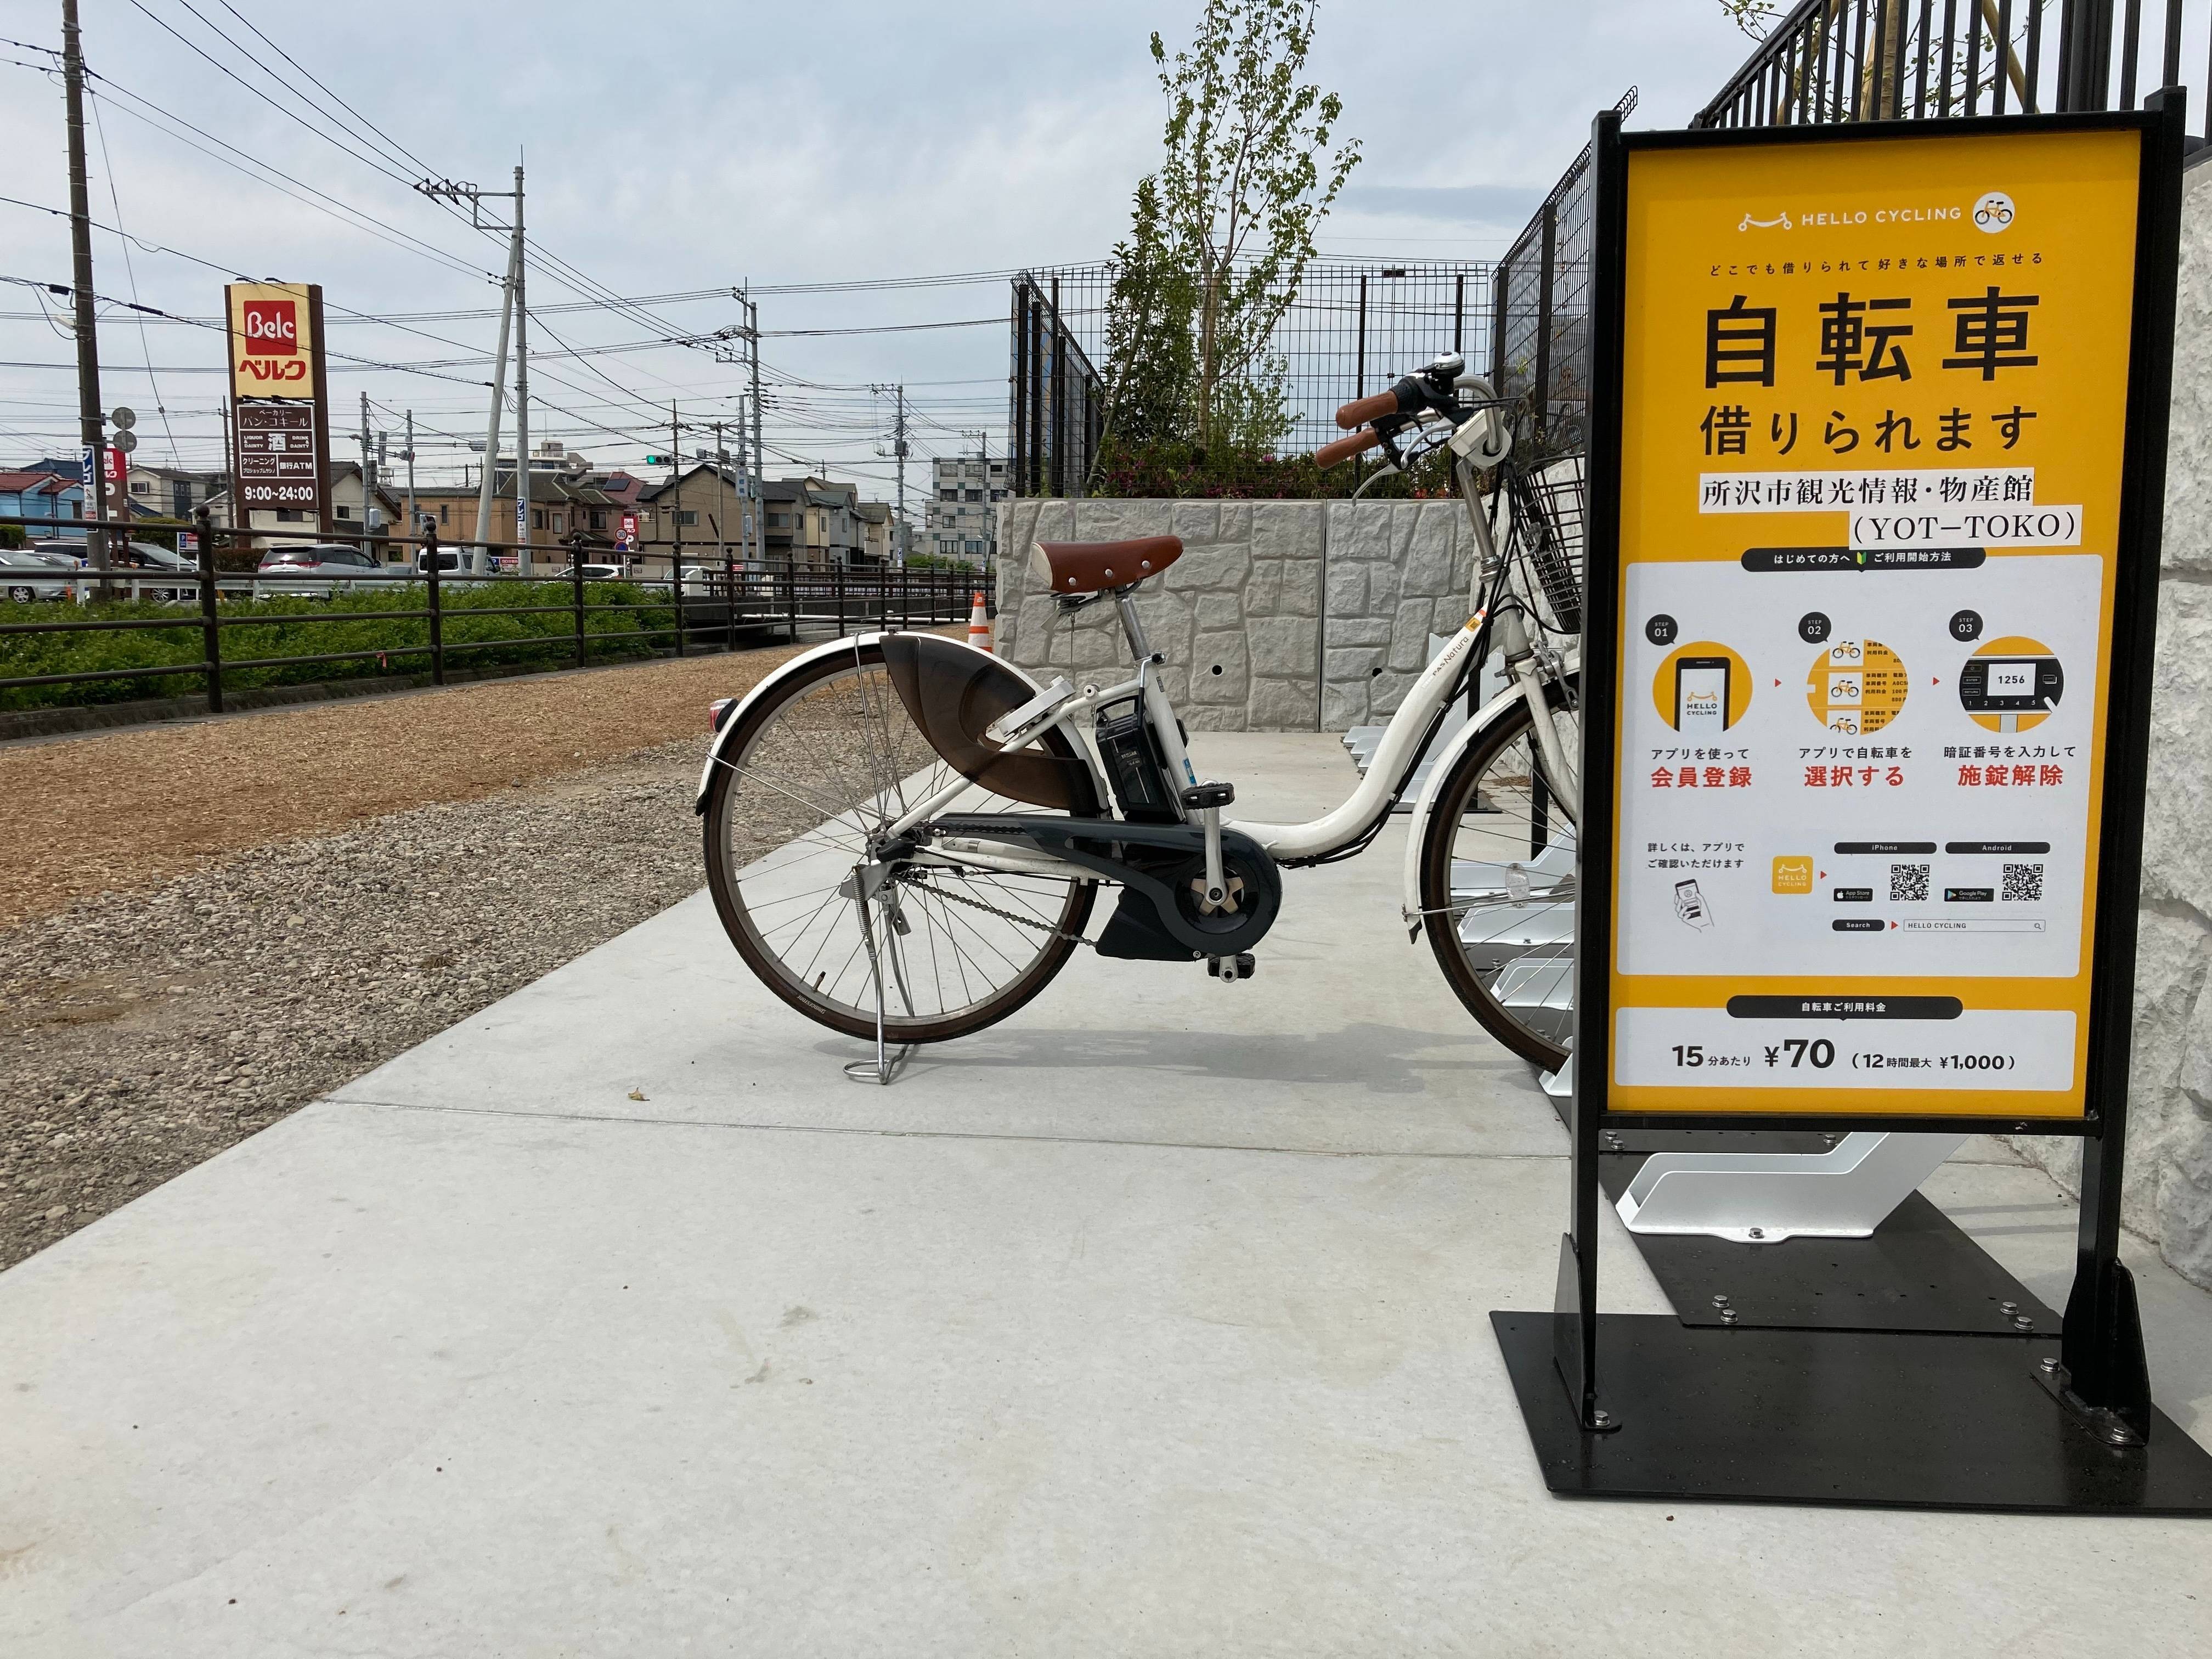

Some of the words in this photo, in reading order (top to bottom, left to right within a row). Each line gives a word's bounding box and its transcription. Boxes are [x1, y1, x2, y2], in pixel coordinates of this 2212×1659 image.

[1801, 211, 1867, 225] HELLO
[1876, 206, 1961, 223] CYCLING
[1709, 252, 2044, 276] どこでも借りられて好きな場所で返せる
[247, 312, 294, 338] Belc
[1704, 286, 2039, 389] 自転車
[239, 360, 306, 380] ベルク
[243, 416, 308, 427] パン・コキール
[1700, 404, 2037, 456] 借りられます
[268, 433, 286, 451] 酒
[1703, 473, 2033, 506] 所沢市観光情報・物産館
[1773, 552, 1850, 565] はじめての方へ
[1874, 551, 1952, 563] ご利用開始方法
[1655, 628, 1668, 637] 01
[1808, 626, 1821, 635] 02
[1959, 624, 1973, 633] 03
[1444, 636, 1469, 664] Natura
[1998, 675, 2025, 684] 1256
[1651, 747, 1750, 761] アプリを使って
[1799, 746, 1912, 760] アプリで自転車を
[1944, 744, 2076, 759] 暗証番号を入力して
[1650, 766, 1753, 788] 会員登録
[1804, 765, 1905, 787] 選択する
[1957, 764, 2064, 787] 施錠解除
[1647, 842, 1745, 852] 詳しくは、アプリで
[1647, 859, 1744, 868] ご確認いただけます
[1801, 1002, 1886, 1013] 自転車ご利用料金
[1765, 1039, 1835, 1069] ¥70
